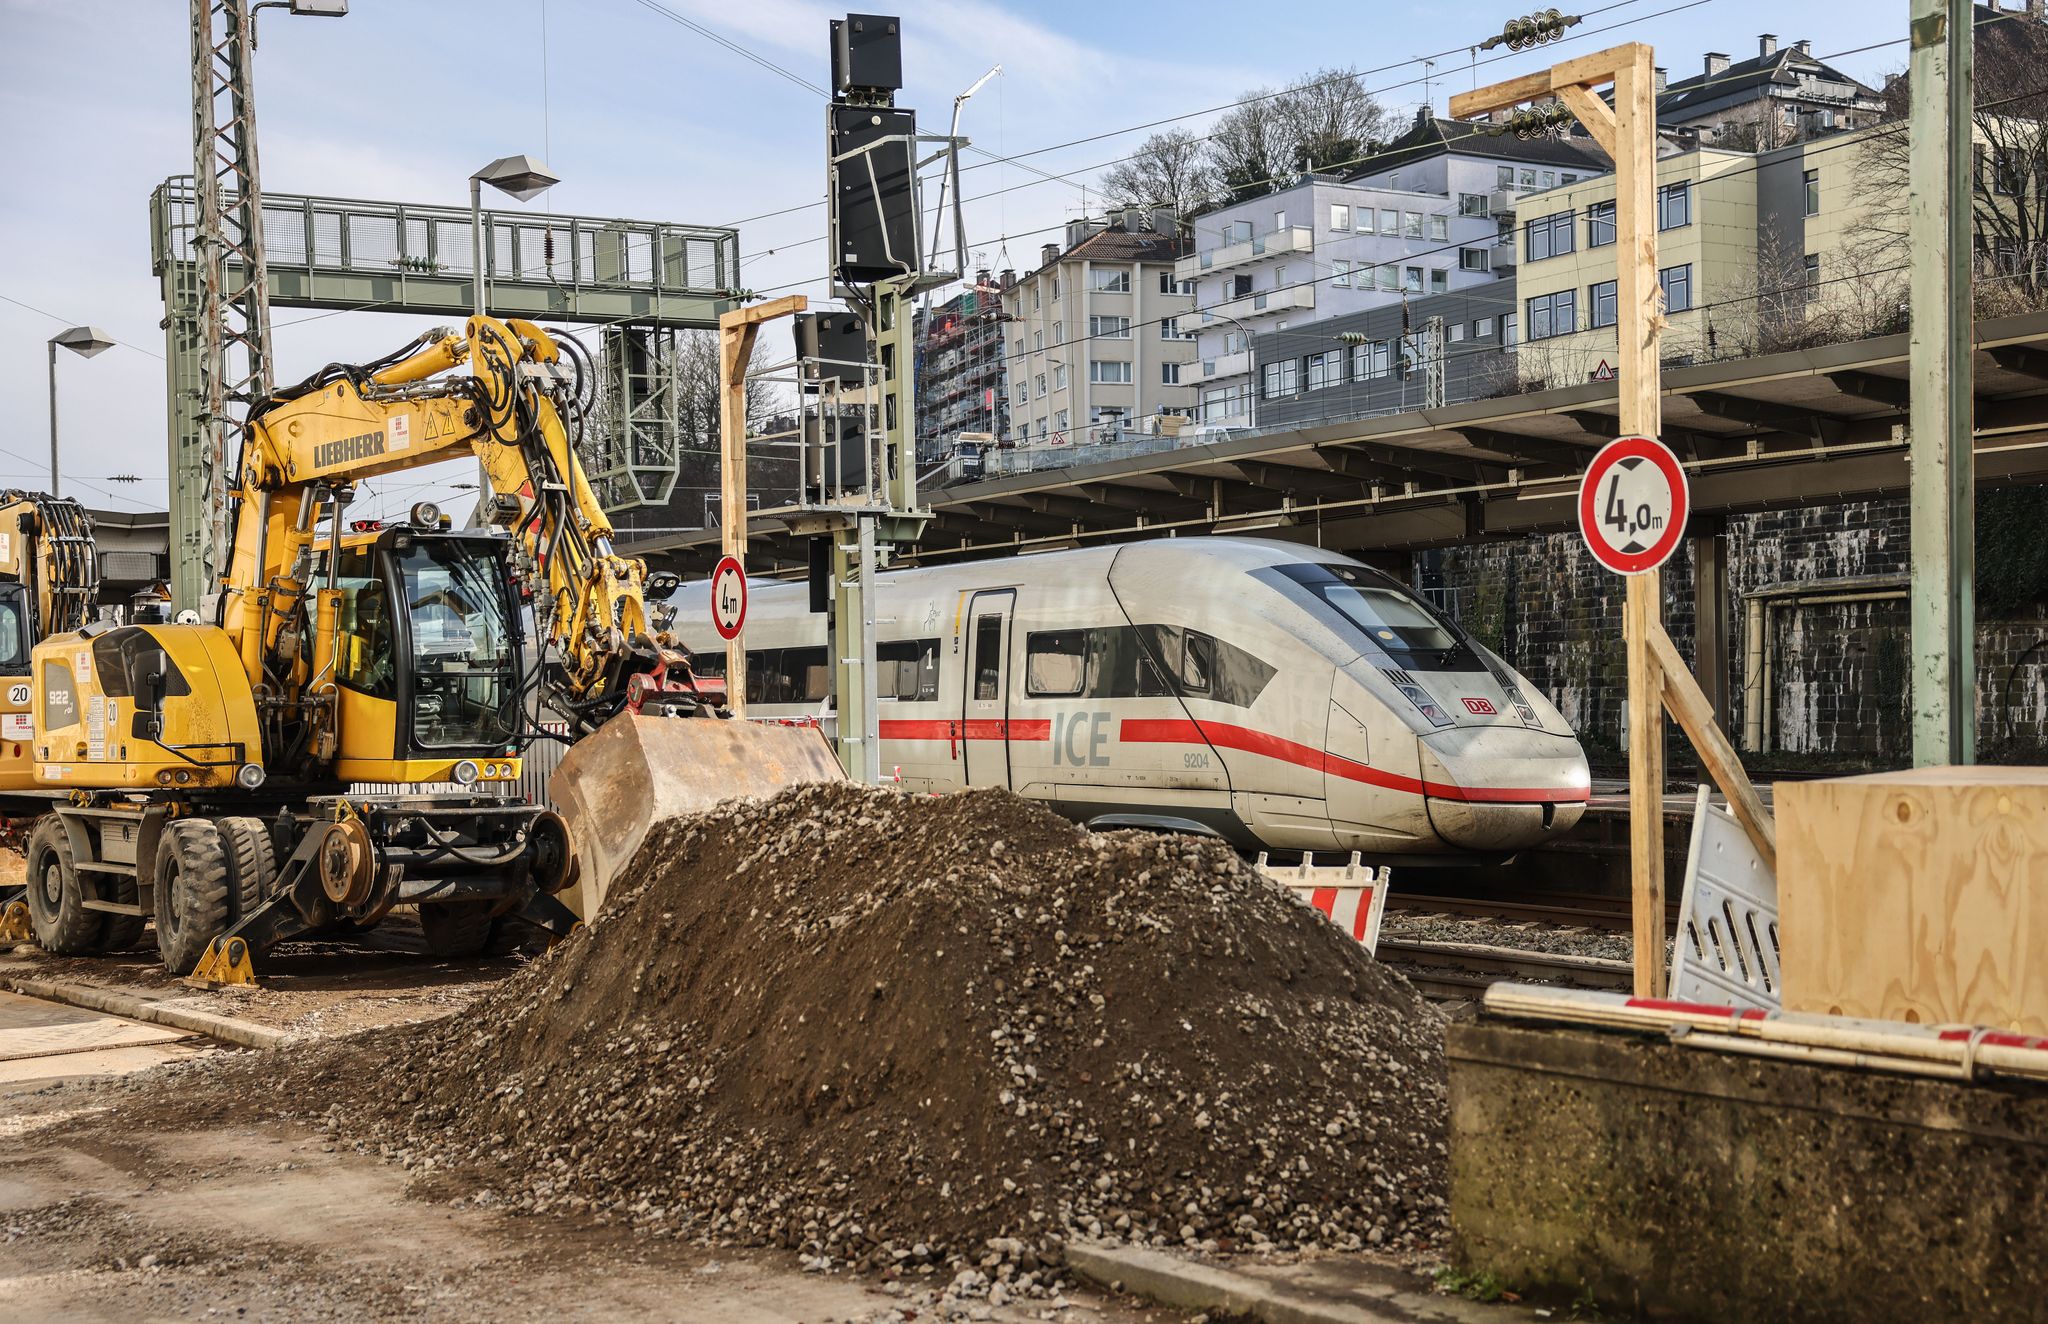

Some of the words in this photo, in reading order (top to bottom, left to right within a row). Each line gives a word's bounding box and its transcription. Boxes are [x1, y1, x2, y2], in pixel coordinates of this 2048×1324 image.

[314, 430, 385, 468] LIEBHERR
[926, 647, 933, 669] 1
[12, 687, 28, 702] 20
[49, 690, 69, 705] 922
[108, 703, 117, 722] 20
[1466, 700, 1492, 712] DB
[1053, 711, 1111, 767] ICE
[1184, 753, 1209, 769] 9204
